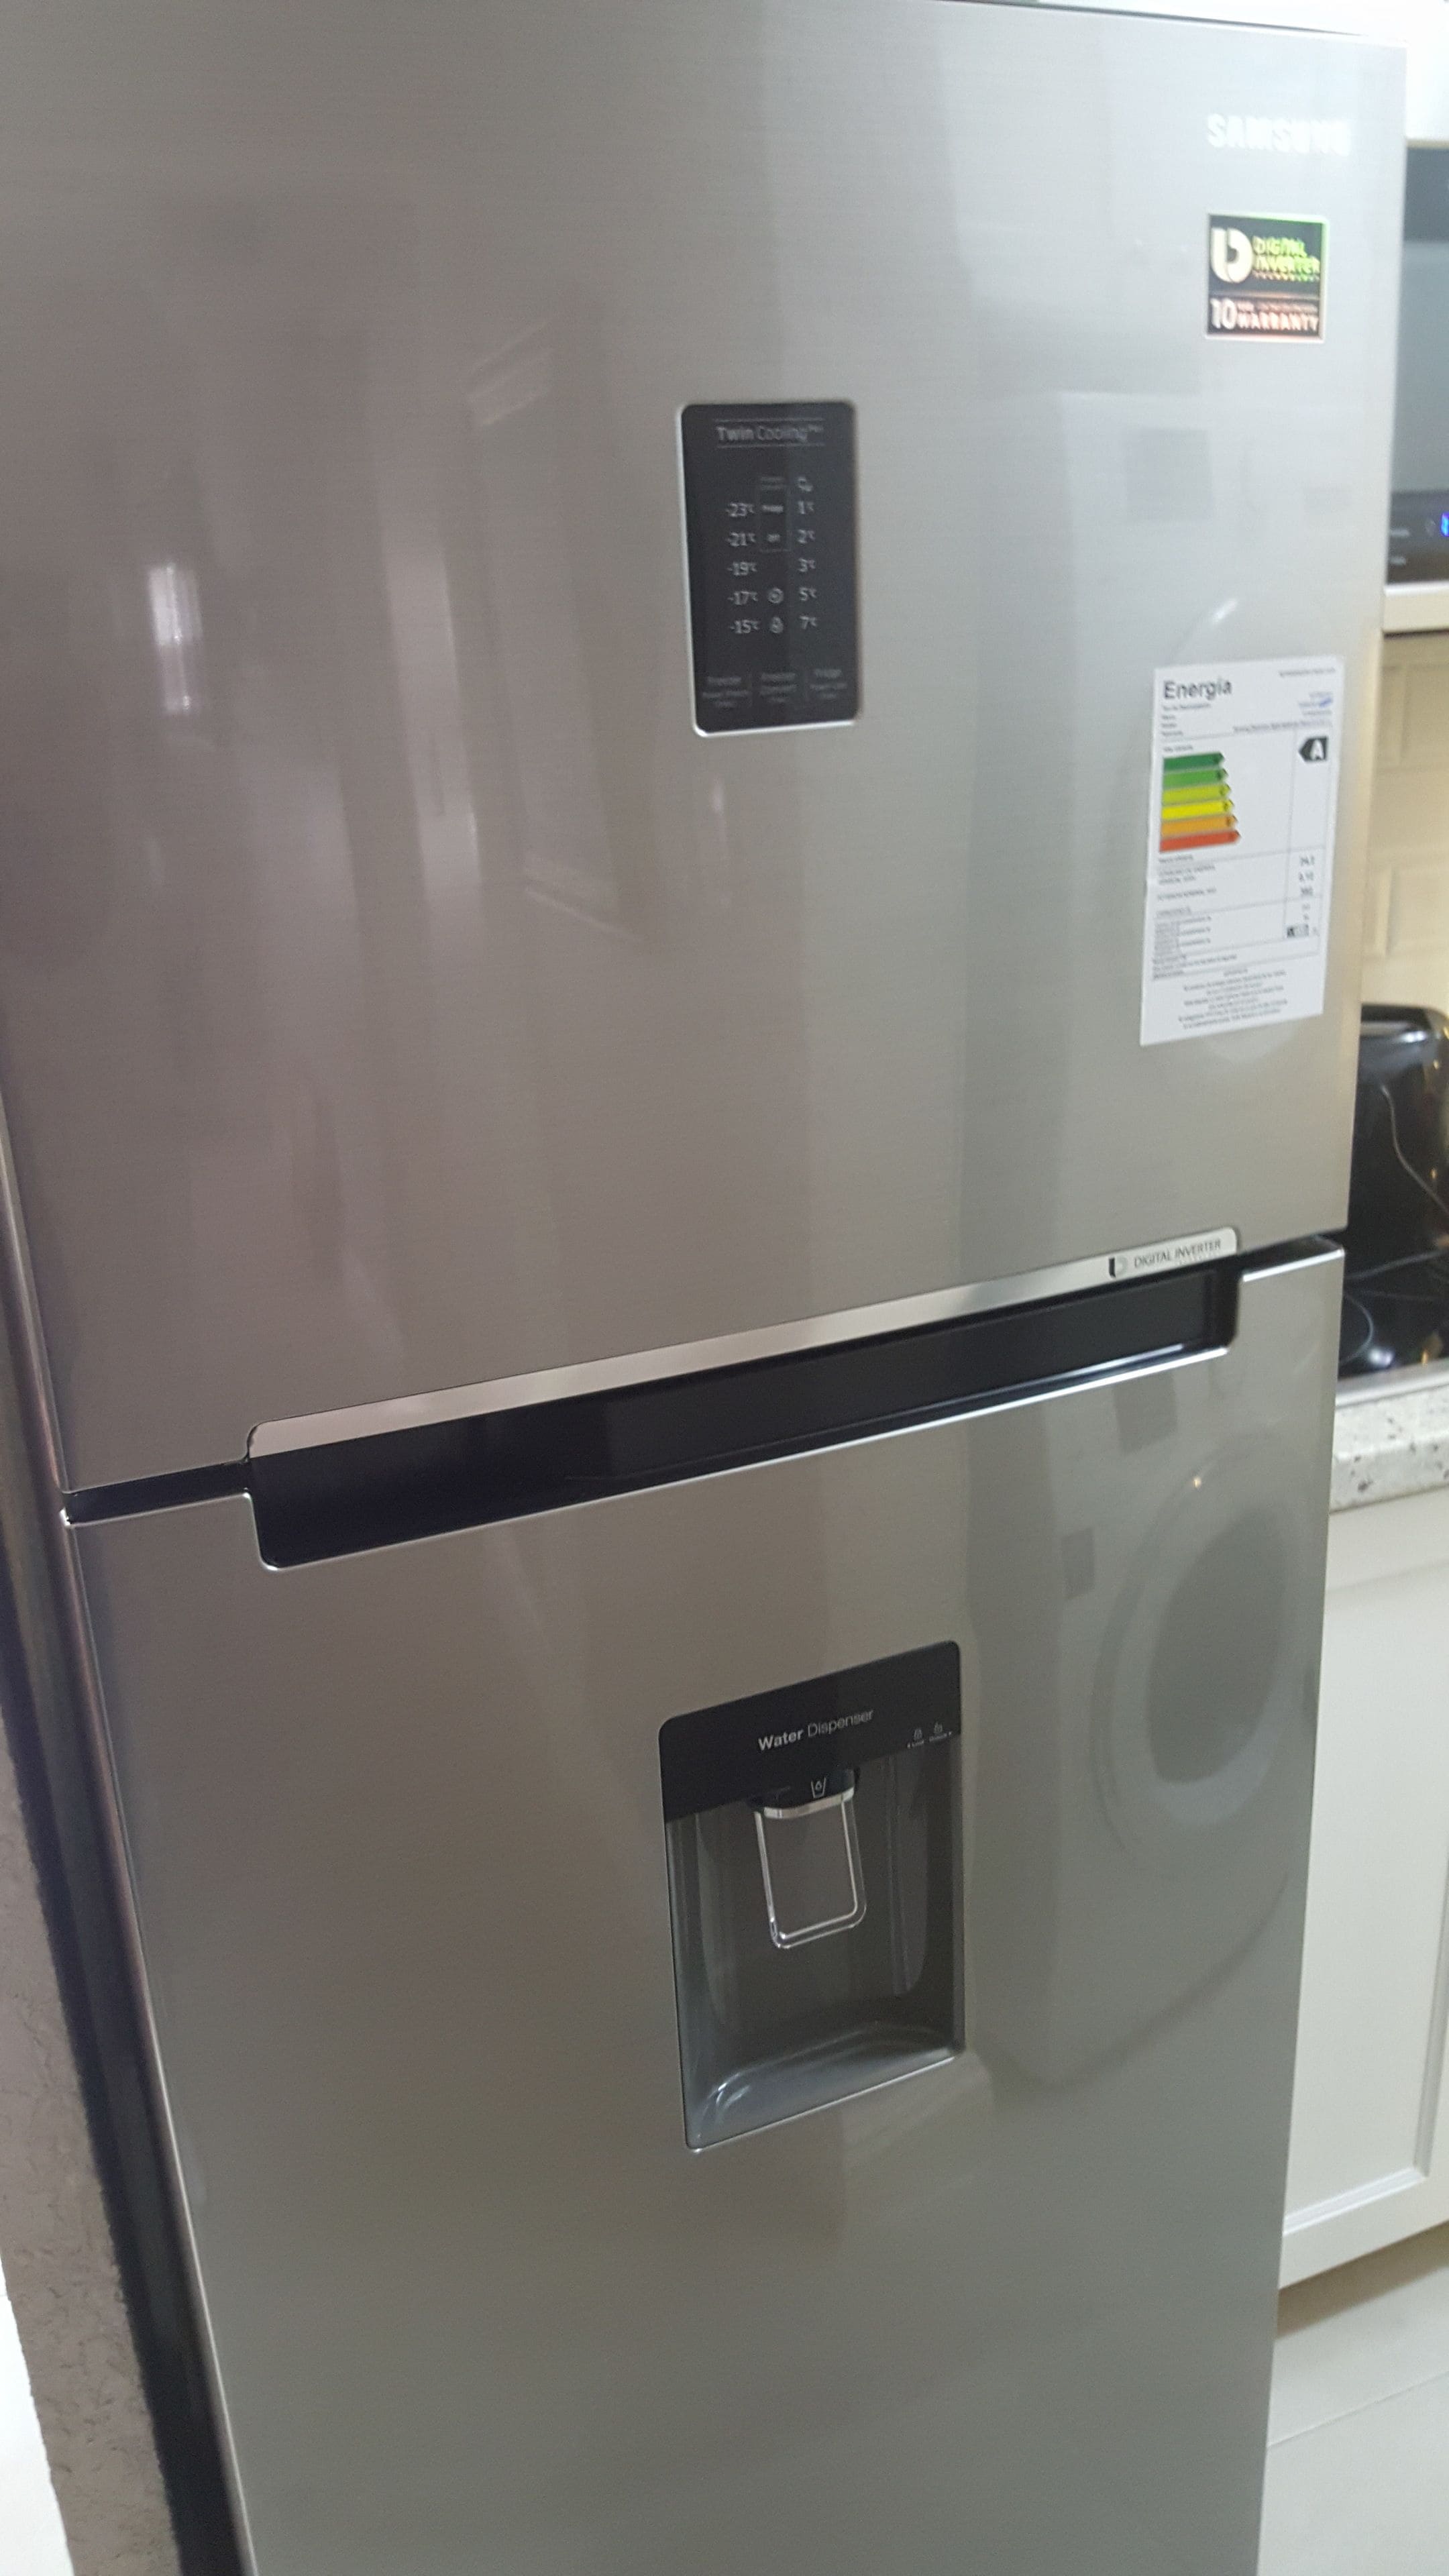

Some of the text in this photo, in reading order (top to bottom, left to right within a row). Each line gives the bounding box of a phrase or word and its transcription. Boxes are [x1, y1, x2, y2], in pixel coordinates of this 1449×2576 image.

[1210, 299, 1238, 329] 10
[1237, 312, 1319, 331] WARRANTY
[716, 426, 755, 442] Twin
[1309, 739, 1324, 760] A
[1134, 1239, 1222, 1269] DIGITAL INVERTER
[758, 1709, 874, 1751] Water Dispenser
